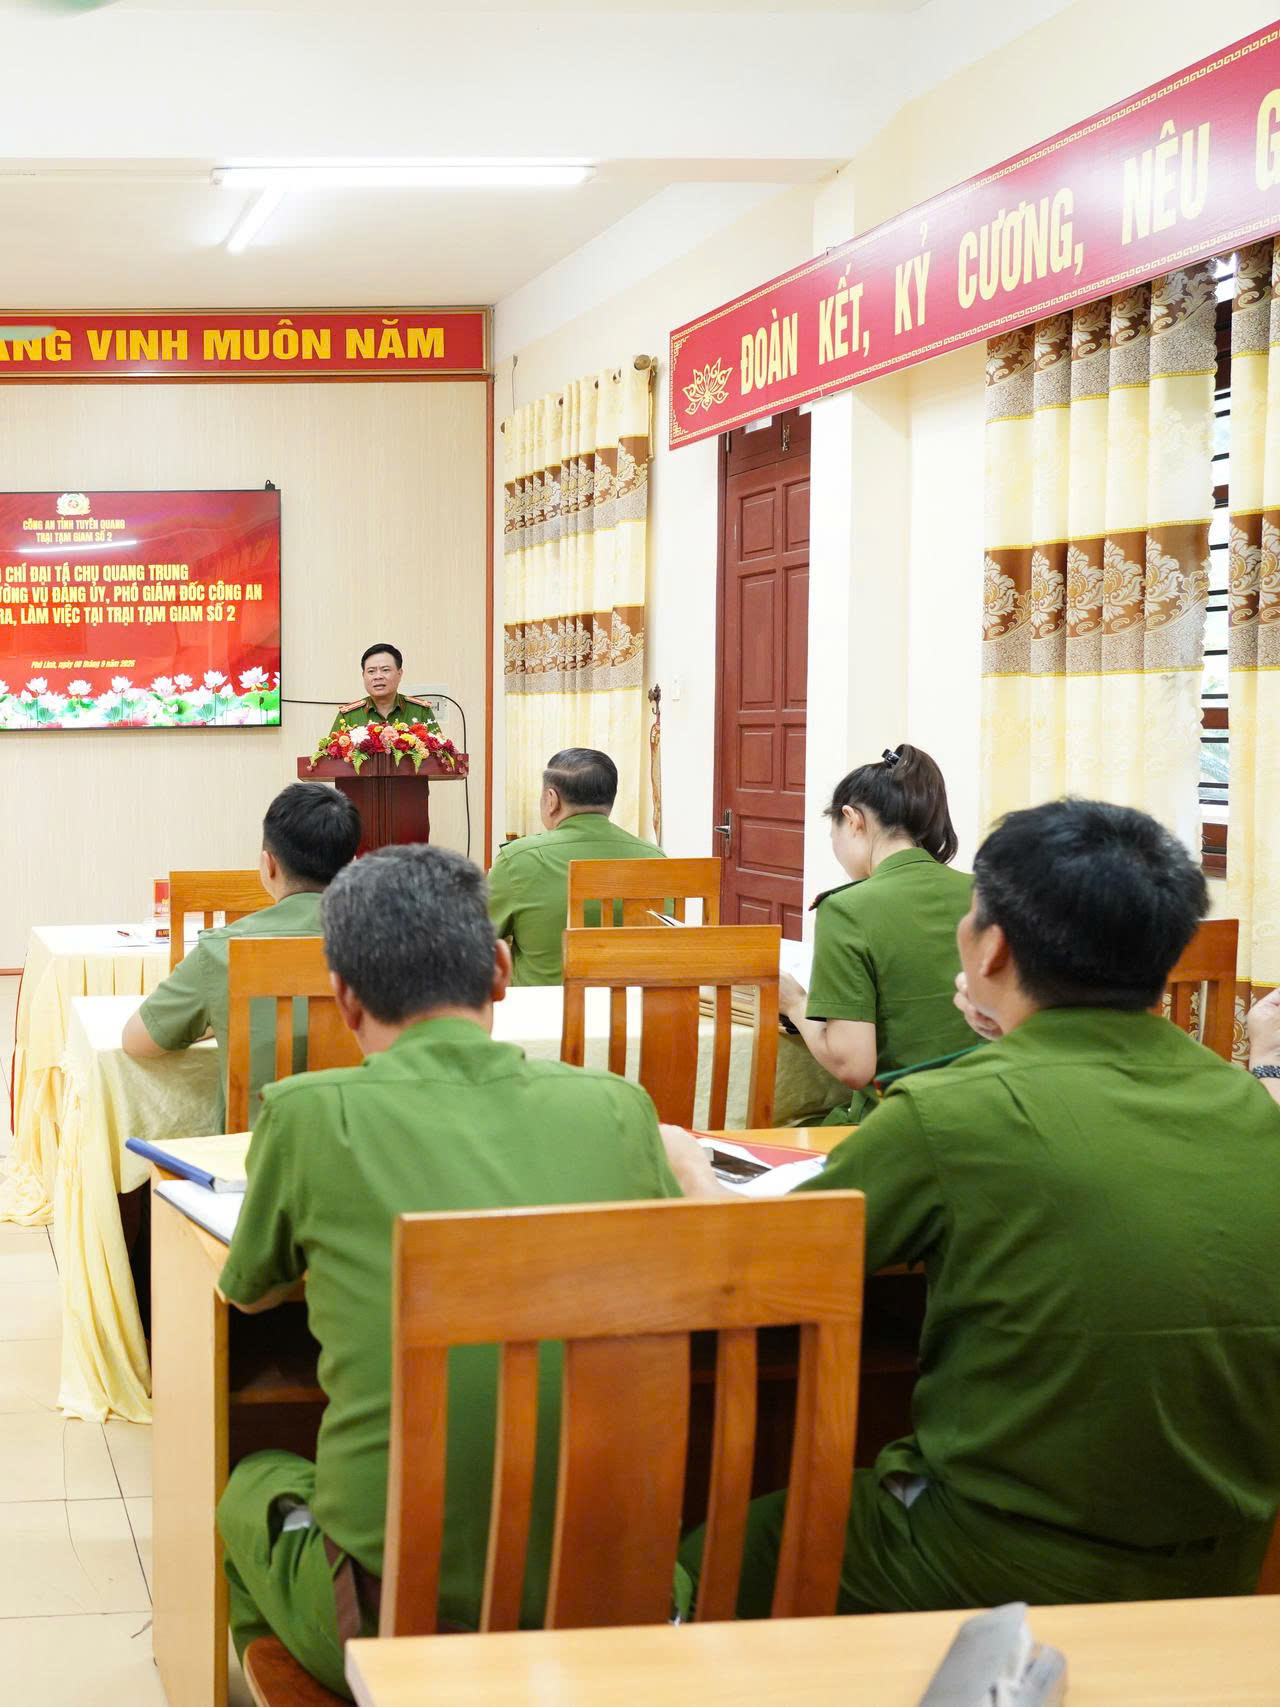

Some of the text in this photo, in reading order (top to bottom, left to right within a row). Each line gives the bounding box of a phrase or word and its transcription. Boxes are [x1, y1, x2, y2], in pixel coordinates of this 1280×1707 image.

[740, 308, 798, 396] ĐOÀN
[818, 262, 870, 365] KẾT,
[894, 222, 931, 336] KỶ
[958, 188, 1084, 309] CƯƠNG,
[1122, 119, 1211, 245] NÊU
[86, 329, 188, 361] VINH
[203, 318, 331, 361] MUÔN
[345, 318, 445, 359] NĂM
[45, 520, 55, 530] AN
[107, 531, 113, 542] 2
[5, 562, 27, 583] CHÍ
[30, 565, 51, 585] ĐẠI
[54, 562, 70, 583] TÁ
[103, 565, 145, 582] QUANG
[149, 564, 189, 581] TRUNG
[32, 587, 48, 607] VỤ
[52, 583, 86, 602] ĐẢNG
[90, 582, 110, 604] ỦY,
[114, 582, 139, 602] PHÓ
[143, 581, 176, 602] GIÁM
[179, 581, 205, 602] ĐỐC
[209, 580, 242, 601] CÔNG
[245, 583, 263, 601] AN
[21, 604, 49, 624] LÀM
[52, 604, 81, 627] VIỆC
[84, 607, 103, 627] TẠI
[107, 607, 134, 626] TRẠI
[138, 606, 166, 625] TẠM
[169, 605, 203, 622] GIAM
[206, 602, 224, 622] SỐ
[226, 605, 236, 621] 2
